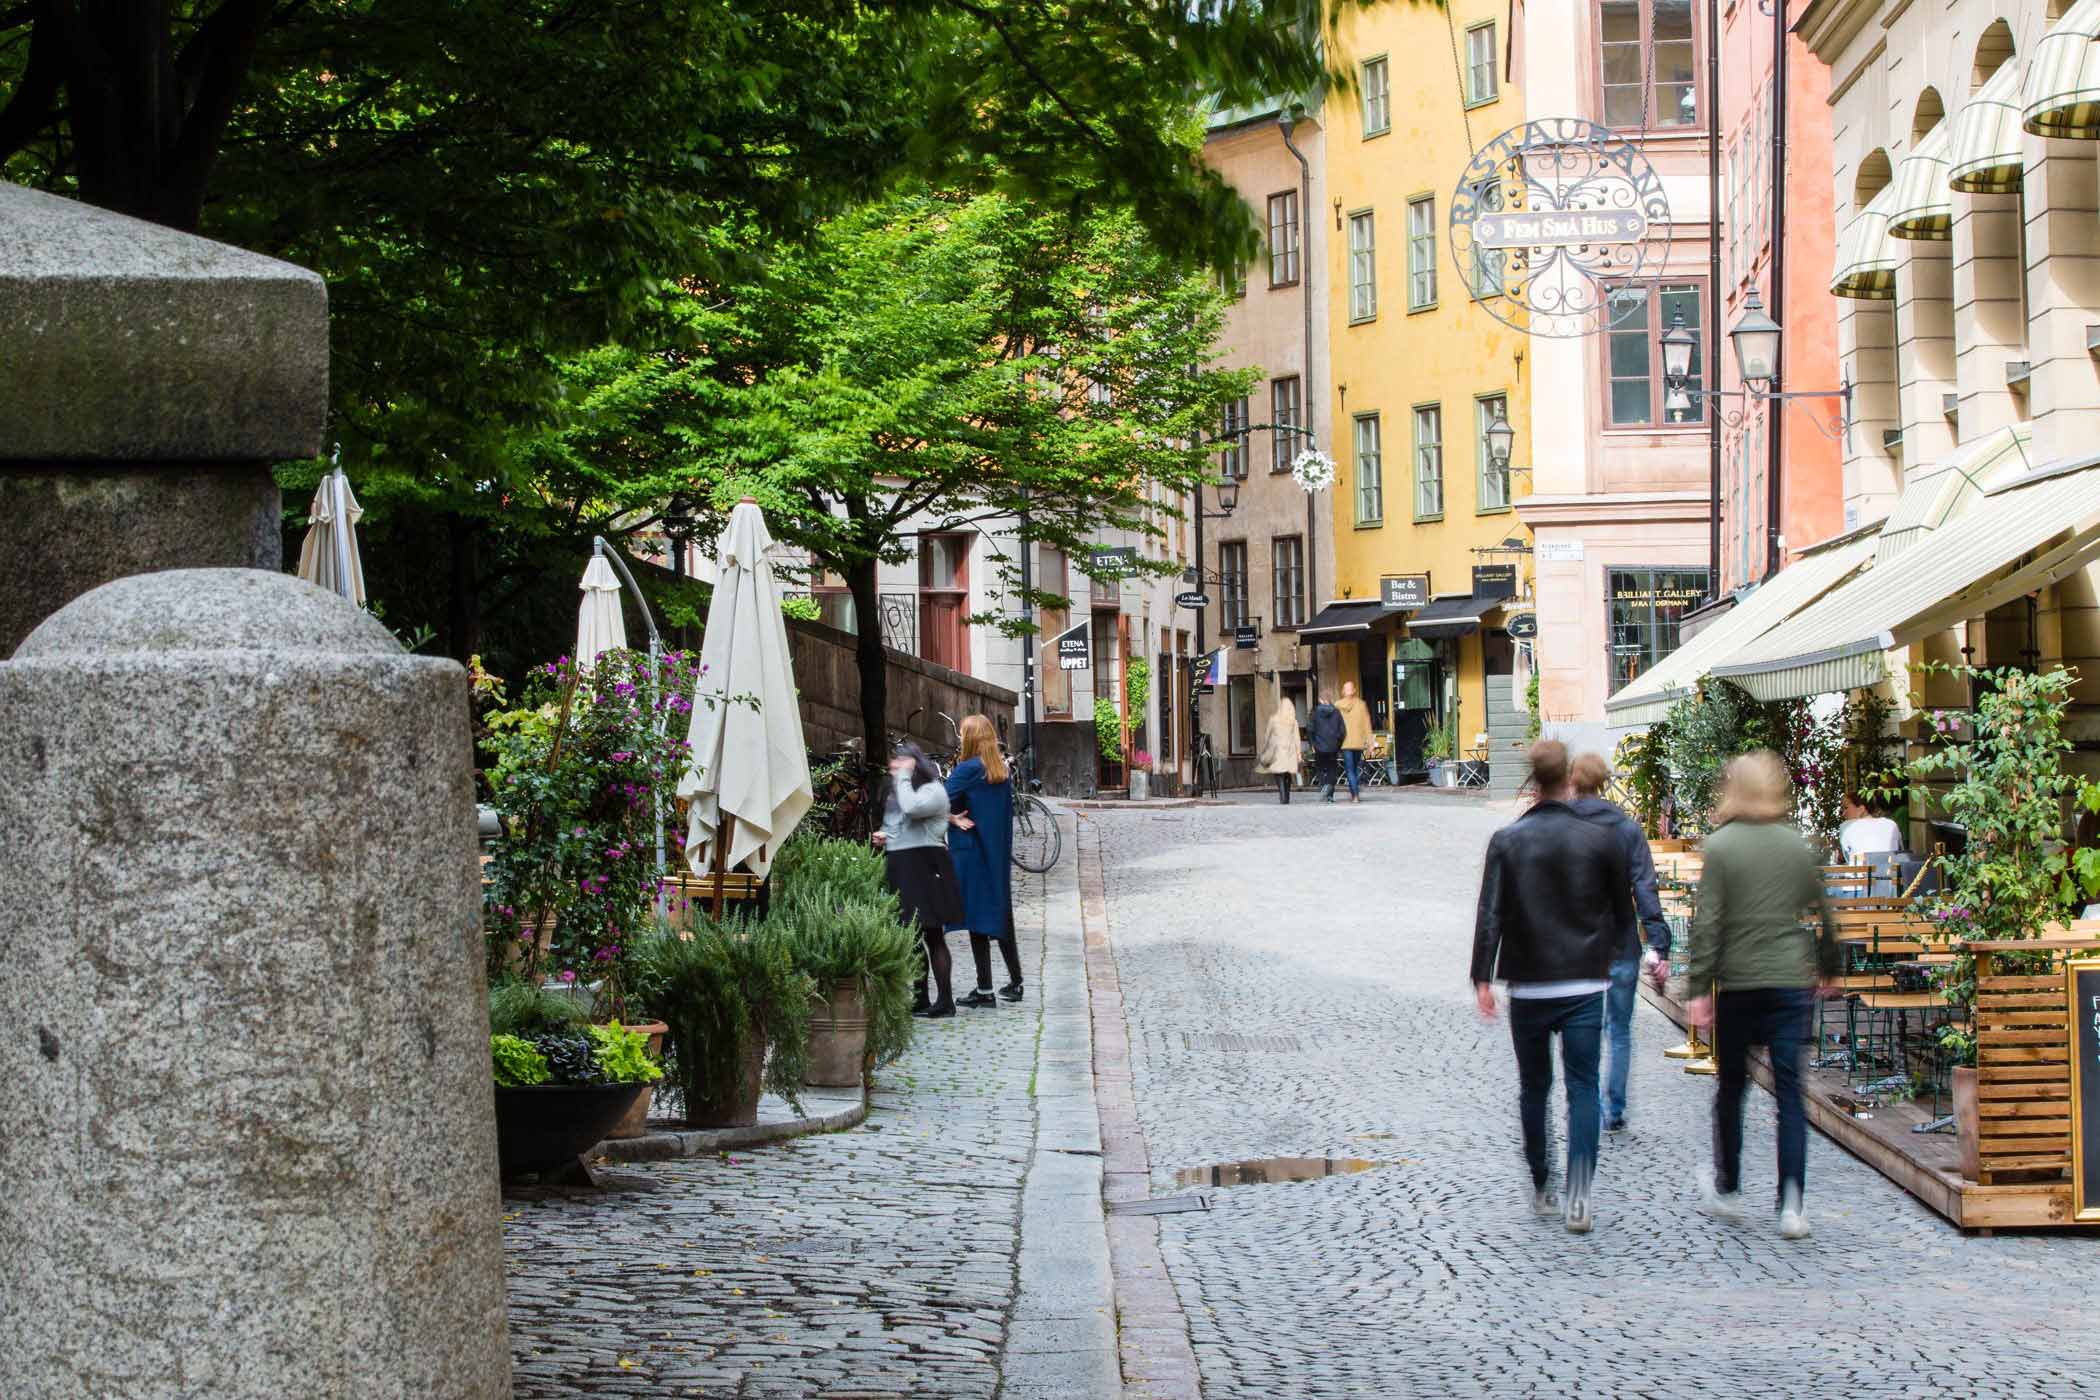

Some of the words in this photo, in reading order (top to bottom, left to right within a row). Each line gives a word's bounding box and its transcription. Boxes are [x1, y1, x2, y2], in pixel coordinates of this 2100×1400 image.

[1452, 119, 1669, 224] RESTAURANG
[1391, 580, 1406, 589] Bar
[1407, 580, 1416, 589] &
[1391, 591, 1417, 600] Bistro
[1061, 640, 1084, 648] ETENA
[1061, 656, 1087, 669] ÖPPET
